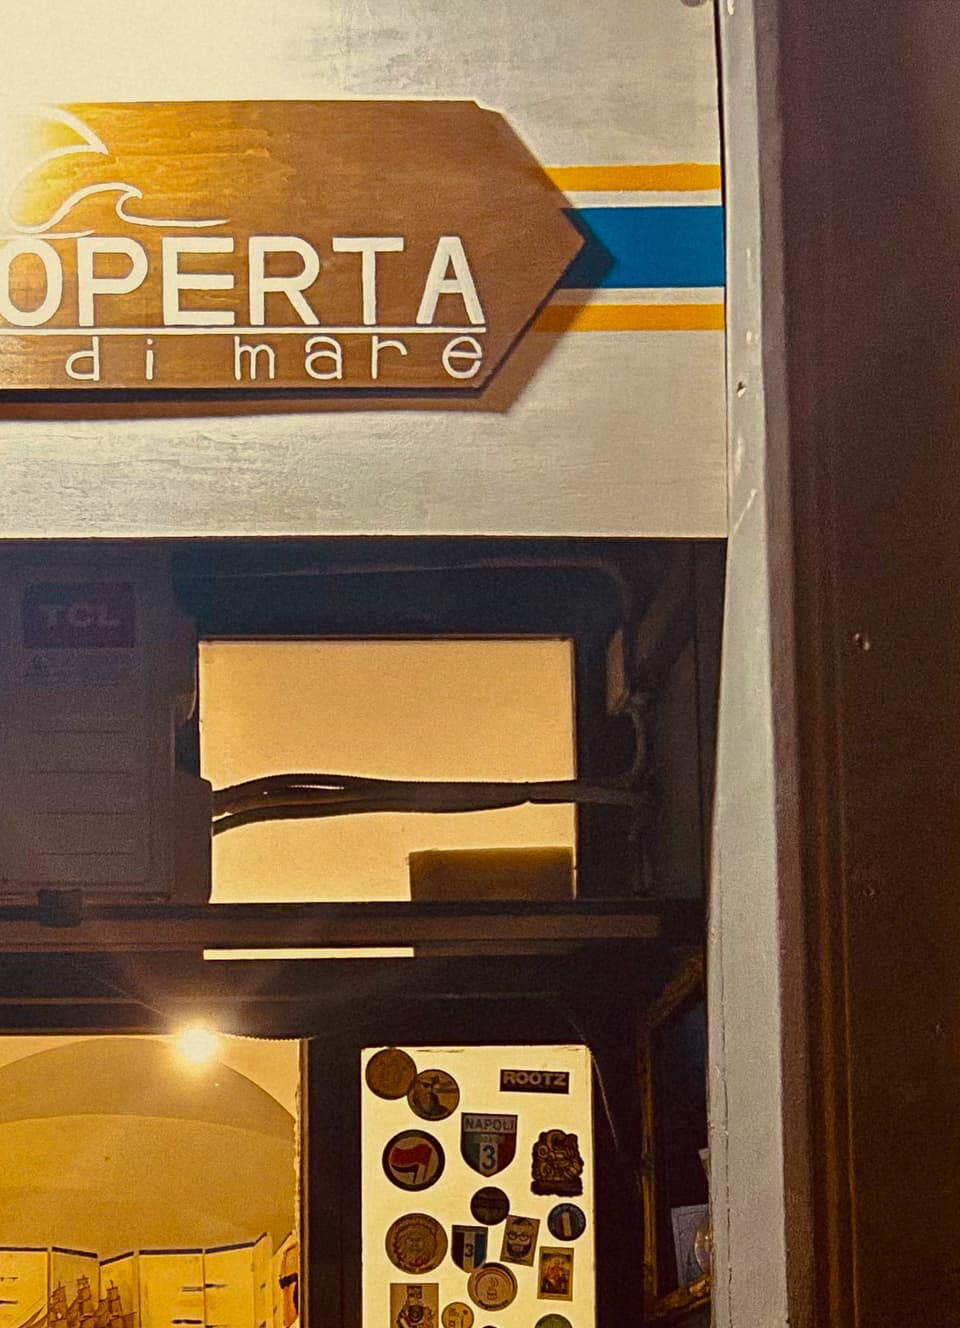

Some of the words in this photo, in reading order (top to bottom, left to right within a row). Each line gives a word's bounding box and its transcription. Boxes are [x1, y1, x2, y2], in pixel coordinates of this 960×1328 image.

[65, 335, 155, 381] di
[233, 334, 484, 381] mare
[503, 1071, 567, 1086] ROOTZ
[464, 1117, 515, 1131] NAPOLI
[481, 1144, 496, 1170] 3
